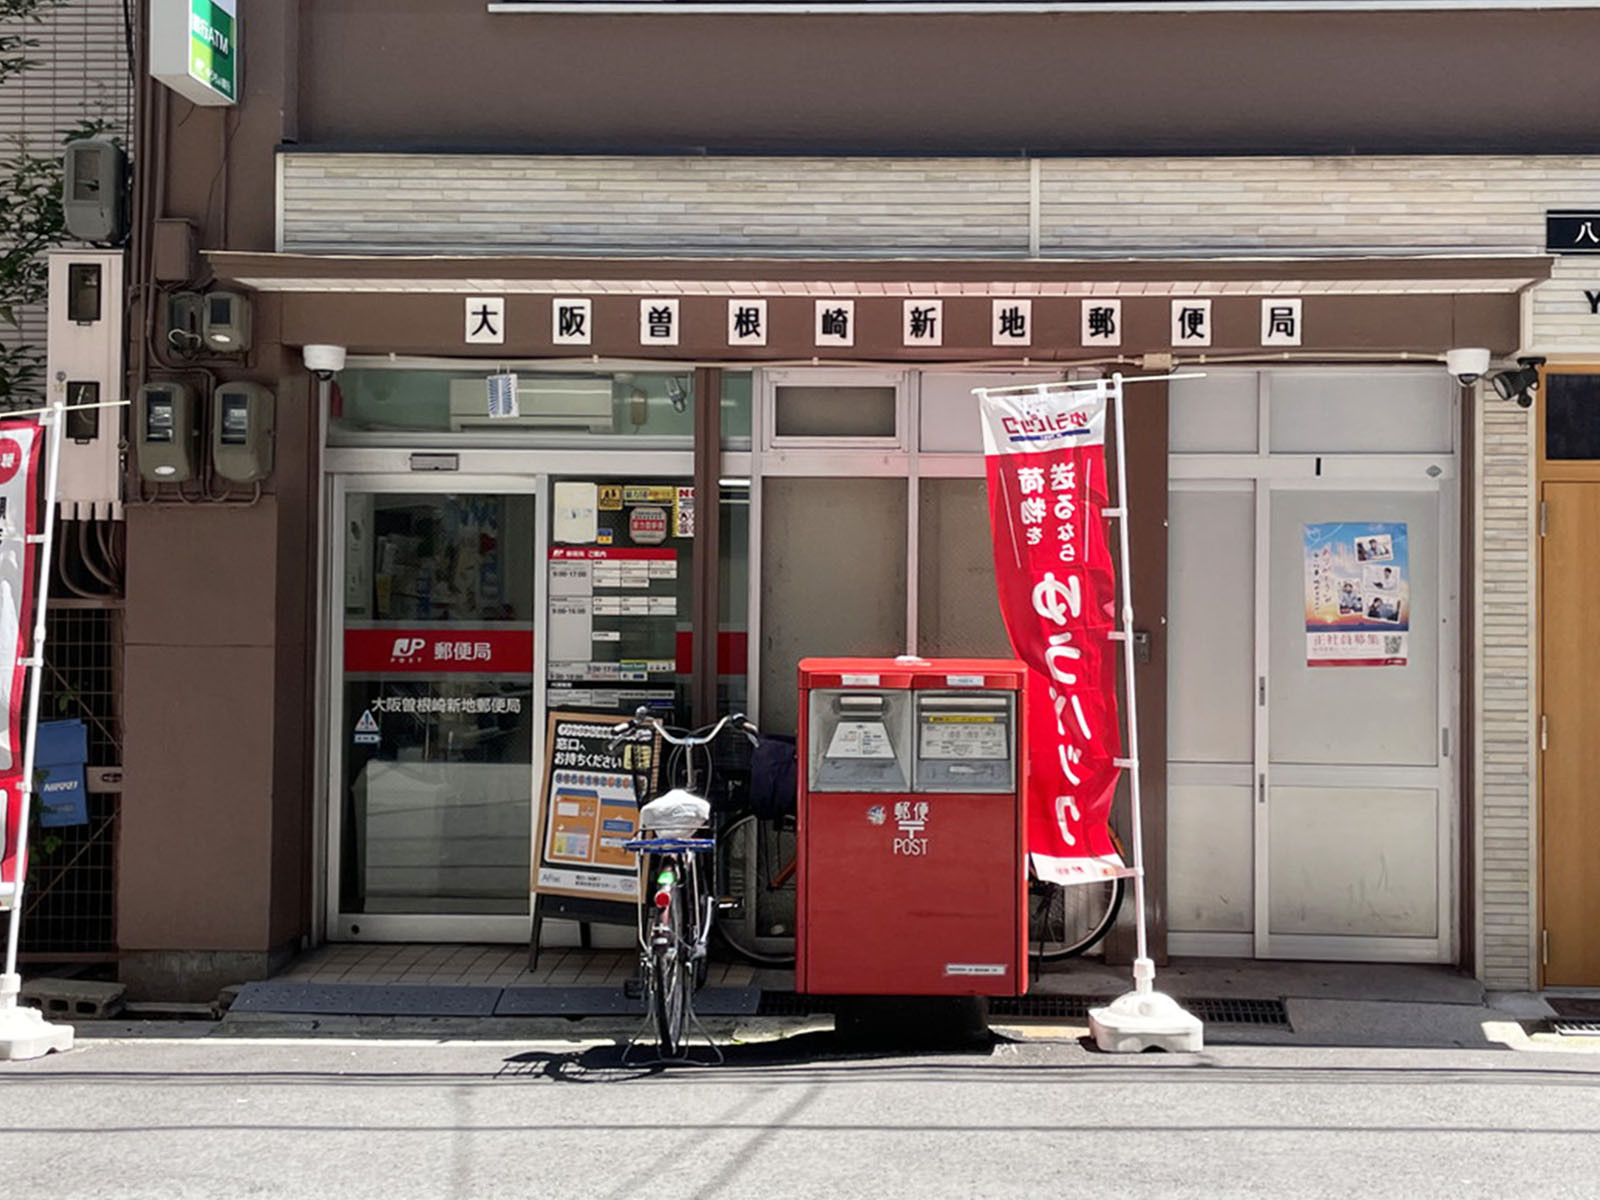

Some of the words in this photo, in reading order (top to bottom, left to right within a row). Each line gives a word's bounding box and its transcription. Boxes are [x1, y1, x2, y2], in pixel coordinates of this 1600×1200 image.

[471, 304, 1296, 339] 大阪曽根崎新地郵便局
[434, 642, 492, 661] 郵便局
[555, 737, 587, 752] 窓口へ
[553, 751, 623, 769] お持ちください
[893, 801, 929, 821] 郵便
[893, 838, 929, 855] POST
